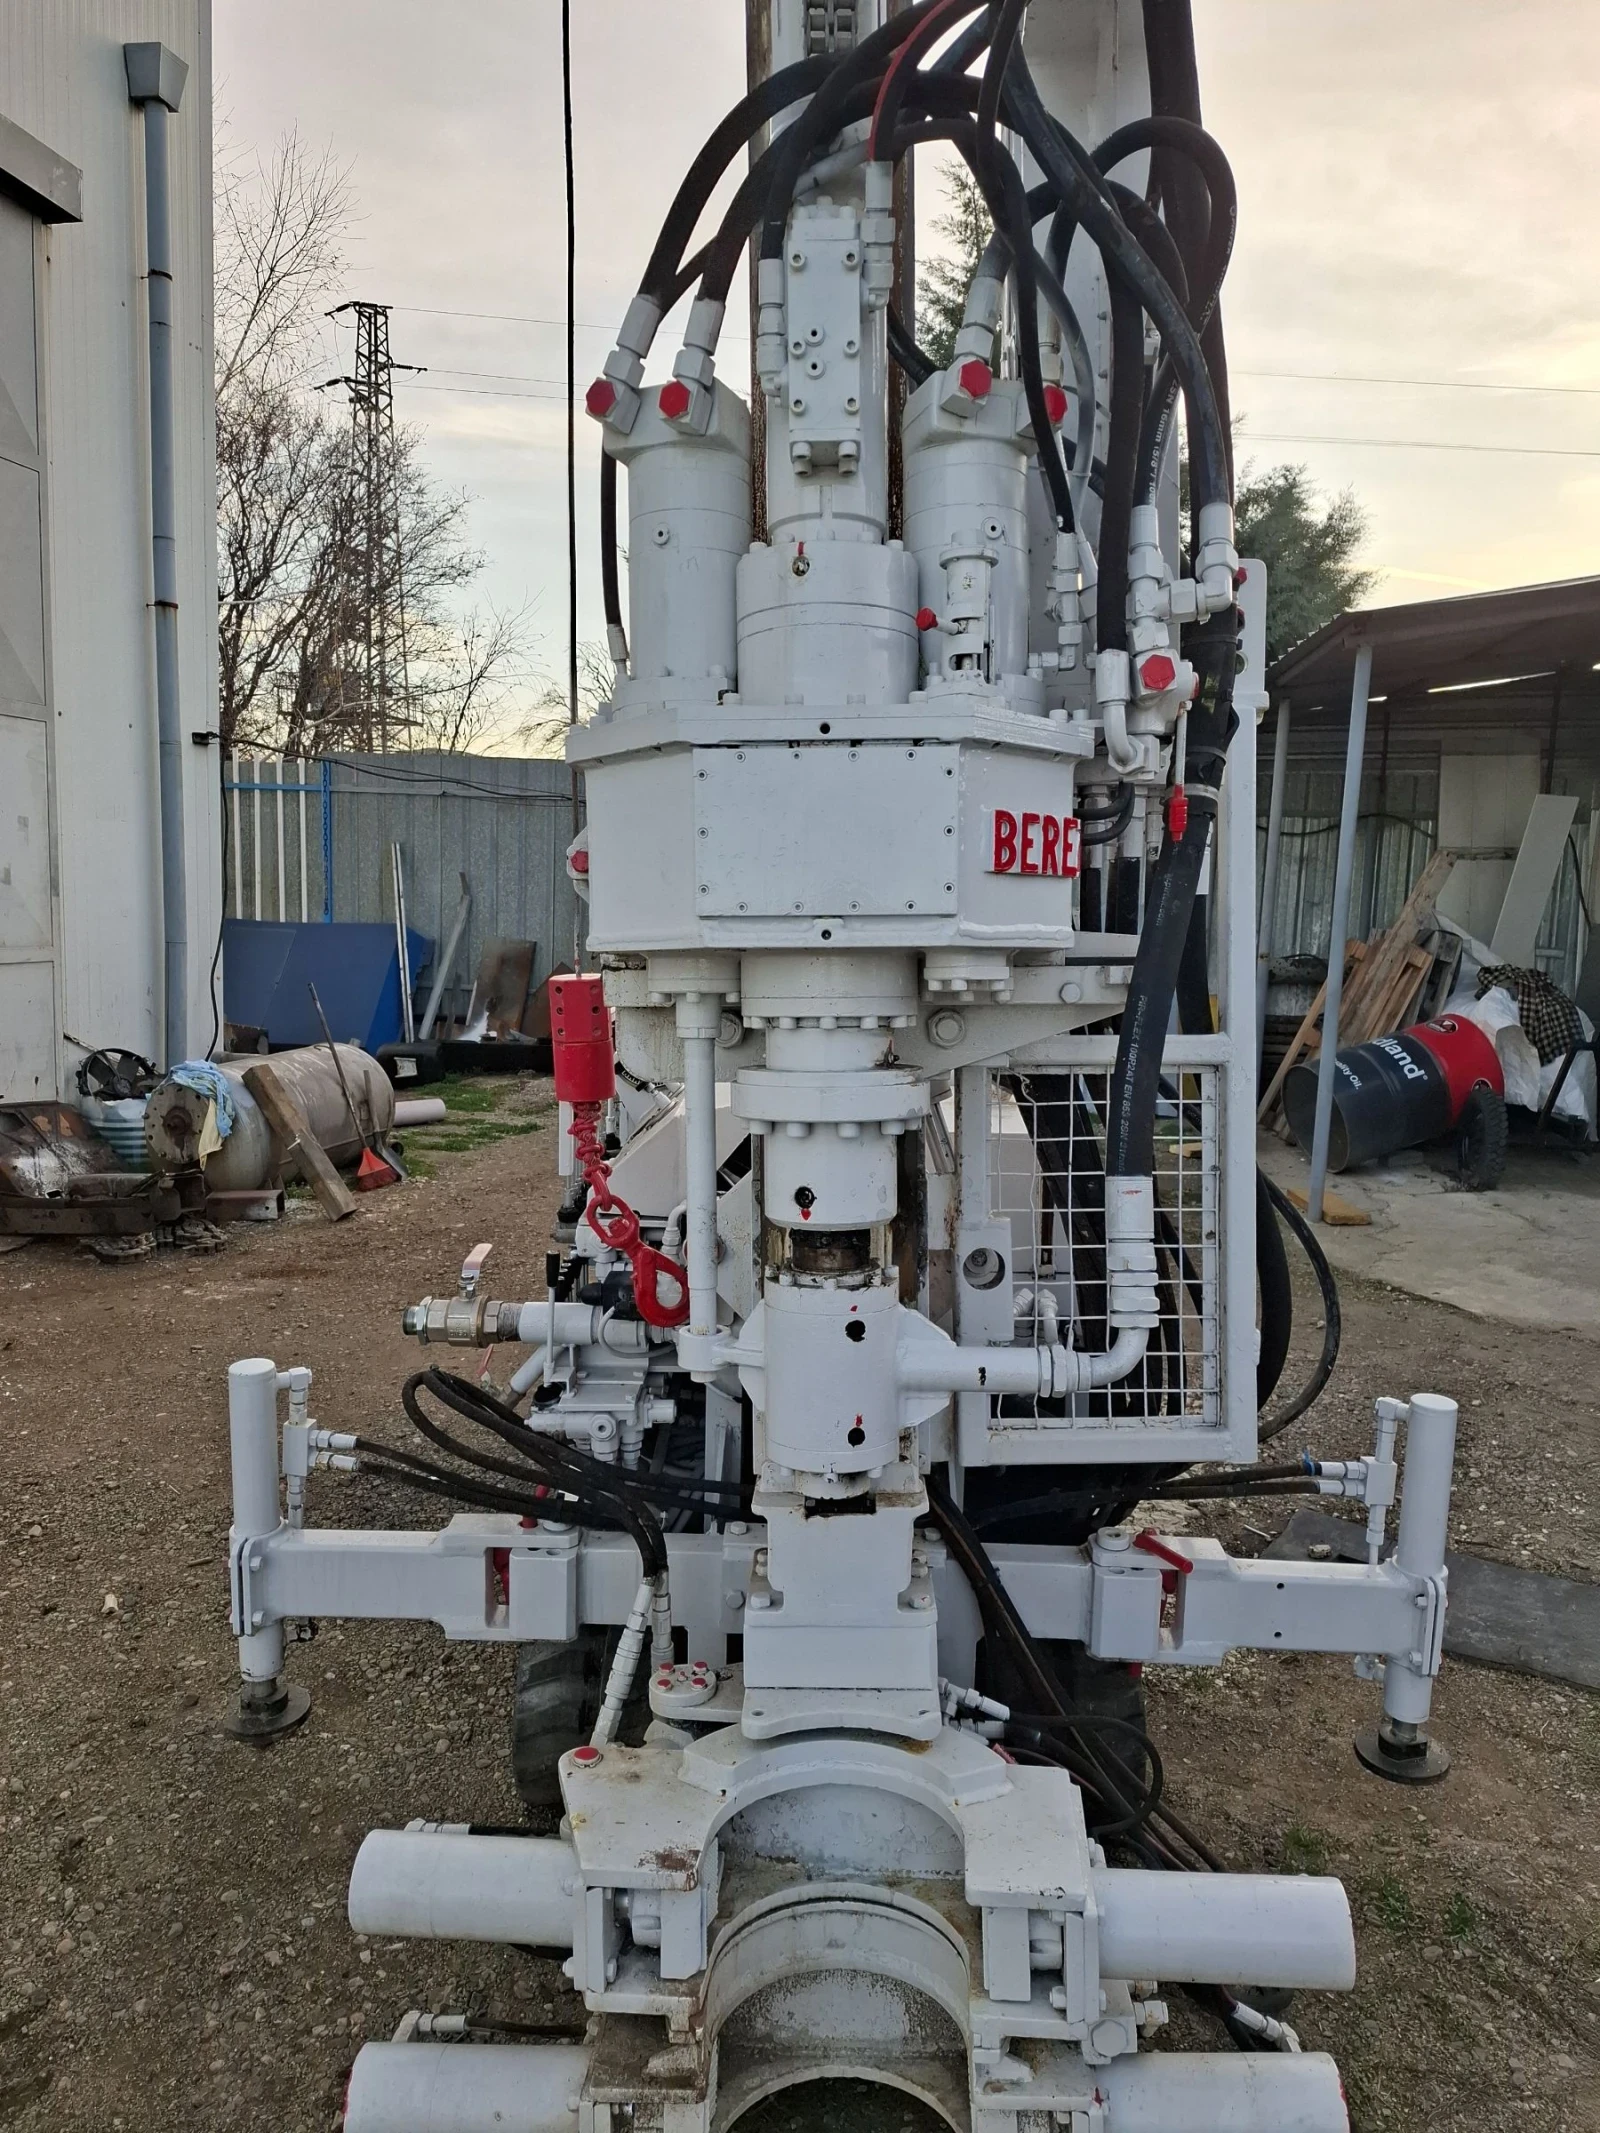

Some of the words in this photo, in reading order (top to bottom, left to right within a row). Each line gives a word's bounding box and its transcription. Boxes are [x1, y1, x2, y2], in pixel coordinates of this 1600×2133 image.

[1155, 408, 1170, 442] 16mm
[993, 809, 1081, 878] BERE
[1124, 1084, 1133, 1099] EN
